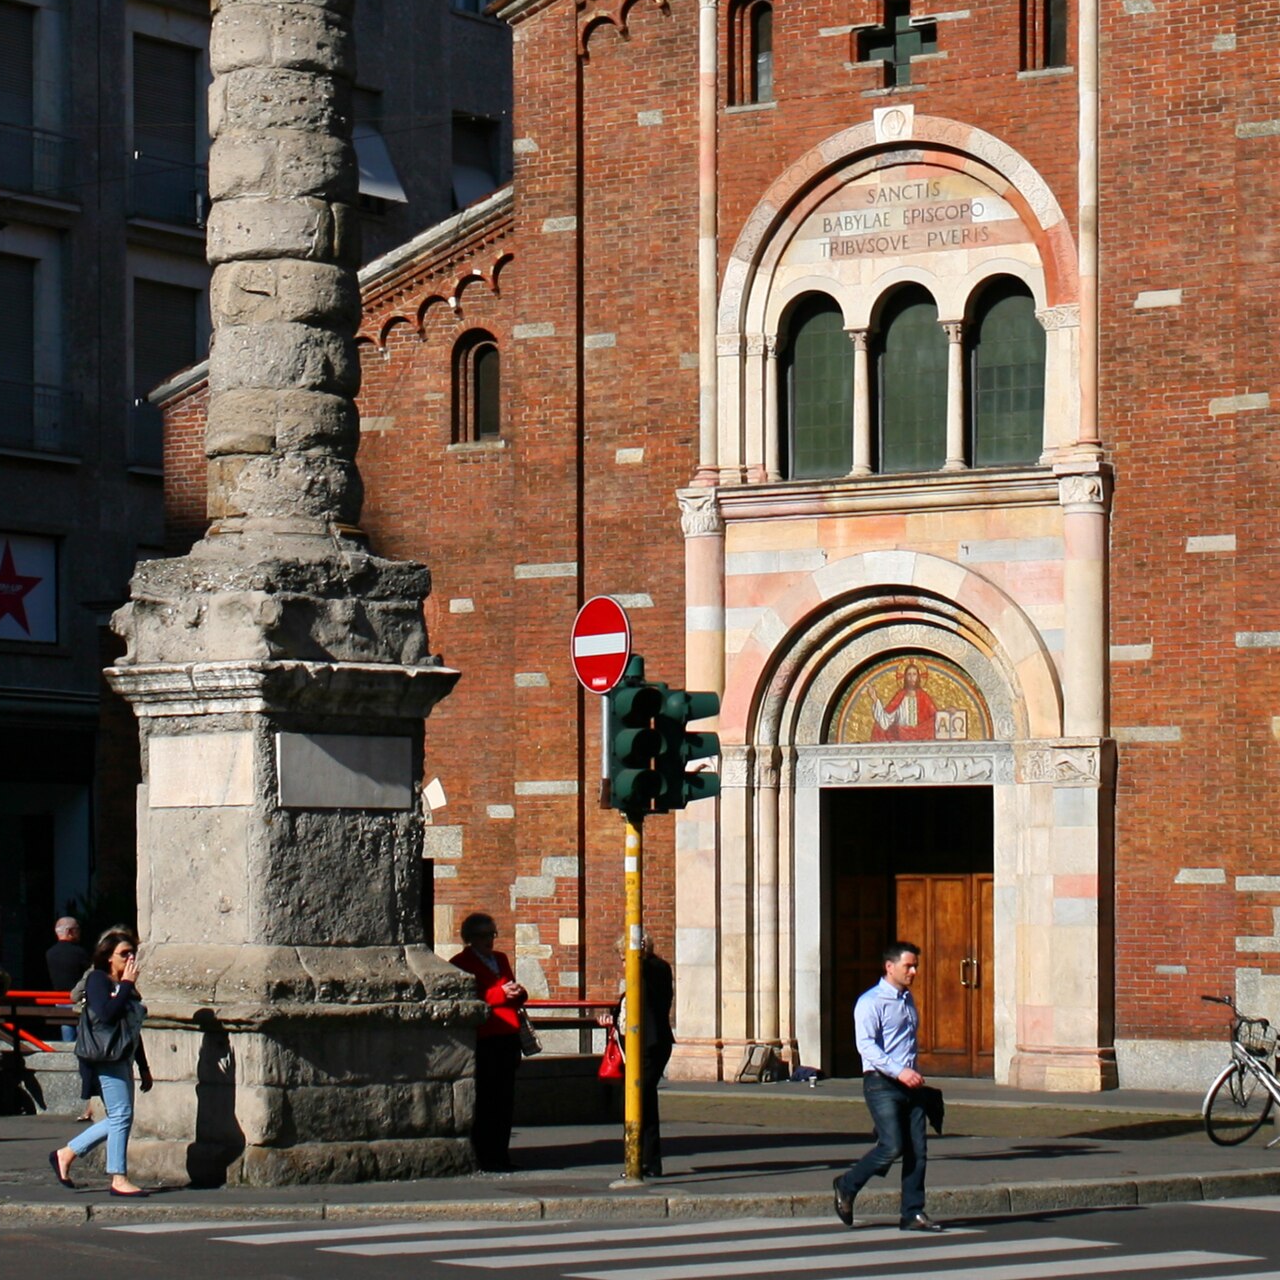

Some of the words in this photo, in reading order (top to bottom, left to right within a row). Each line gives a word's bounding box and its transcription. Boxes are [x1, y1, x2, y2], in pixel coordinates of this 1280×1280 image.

[866, 181, 941, 204] SANCTIS
[823, 211, 890, 233] BABYLAE
[903, 202, 985, 225] EPISCOPO
[820, 233, 910, 257] TRIBVSQVE
[927, 226, 989, 248] PVERIS
[952, 717, 964, 733] Ω
